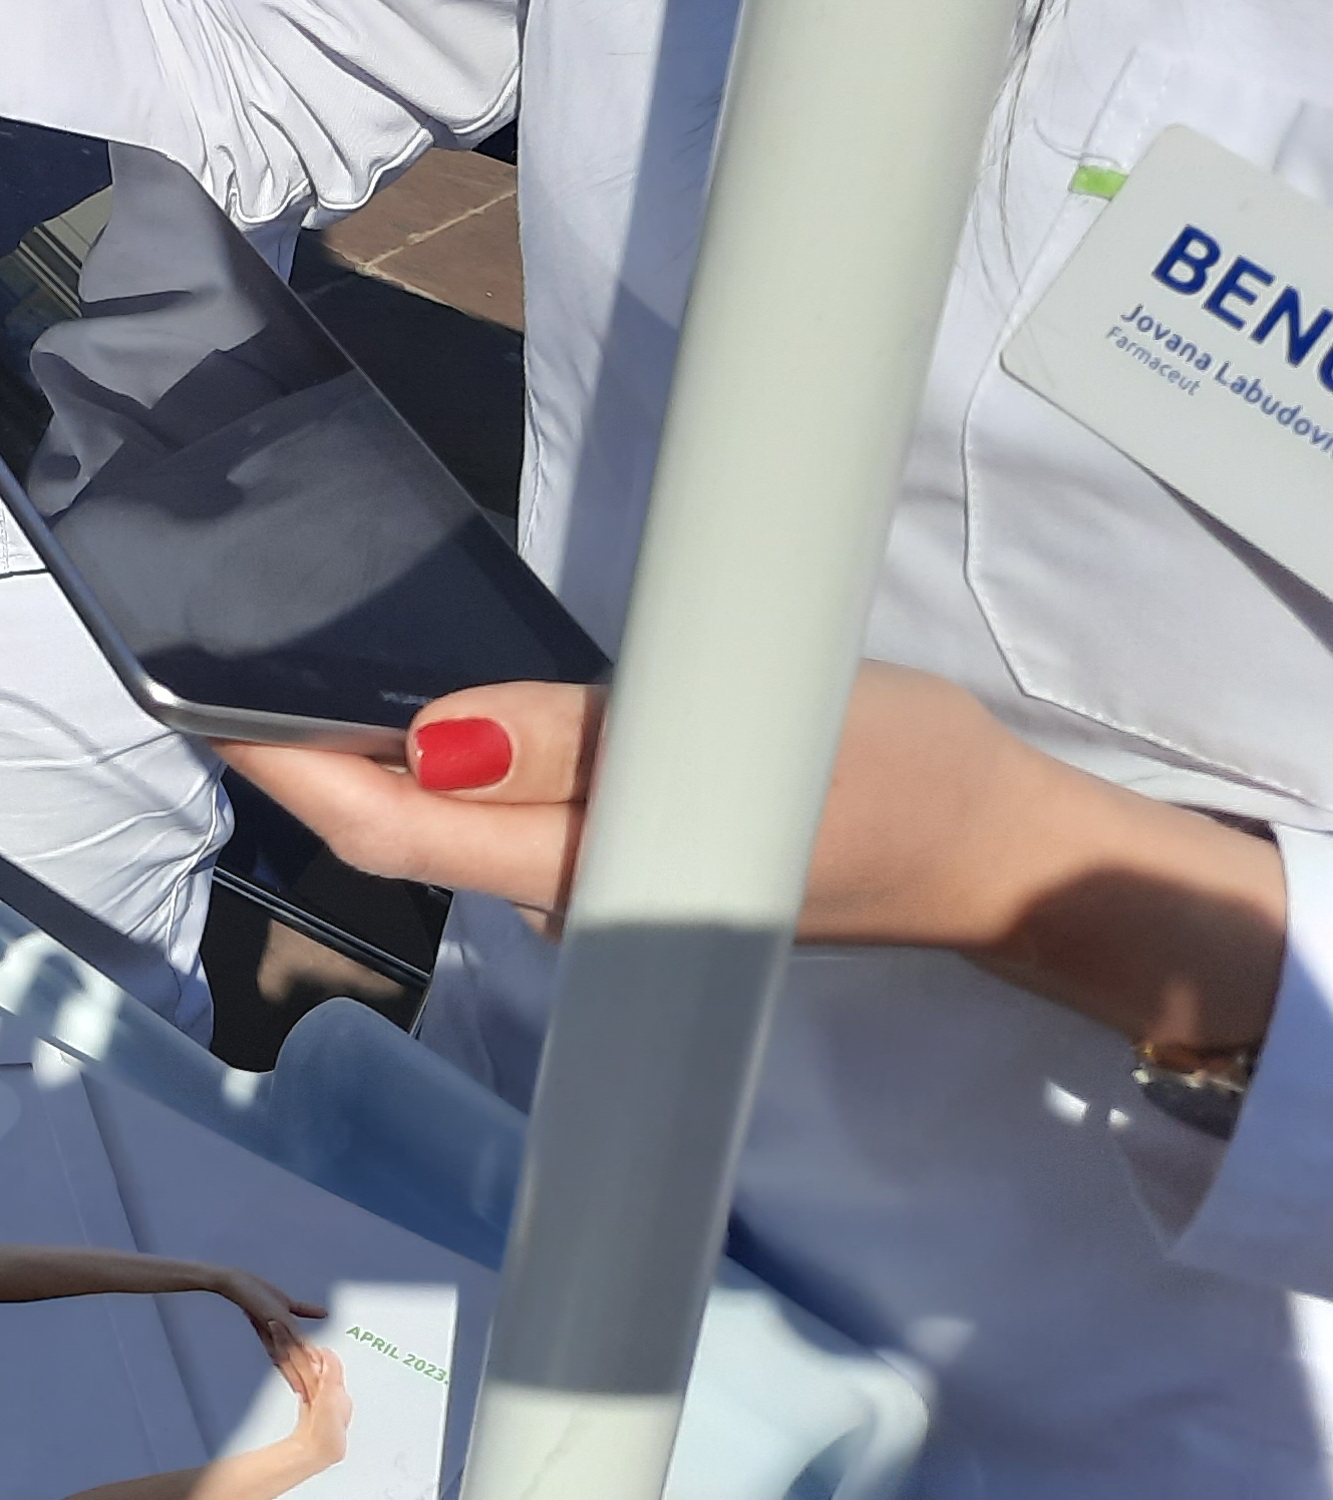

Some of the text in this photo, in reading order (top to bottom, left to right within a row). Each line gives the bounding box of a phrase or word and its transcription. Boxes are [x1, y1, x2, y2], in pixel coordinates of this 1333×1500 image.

[1105, 325, 1202, 398] Farmaceut
[1121, 303, 1214, 372] Jovana
[345, 1325, 449, 1385] APRIL 2023.
